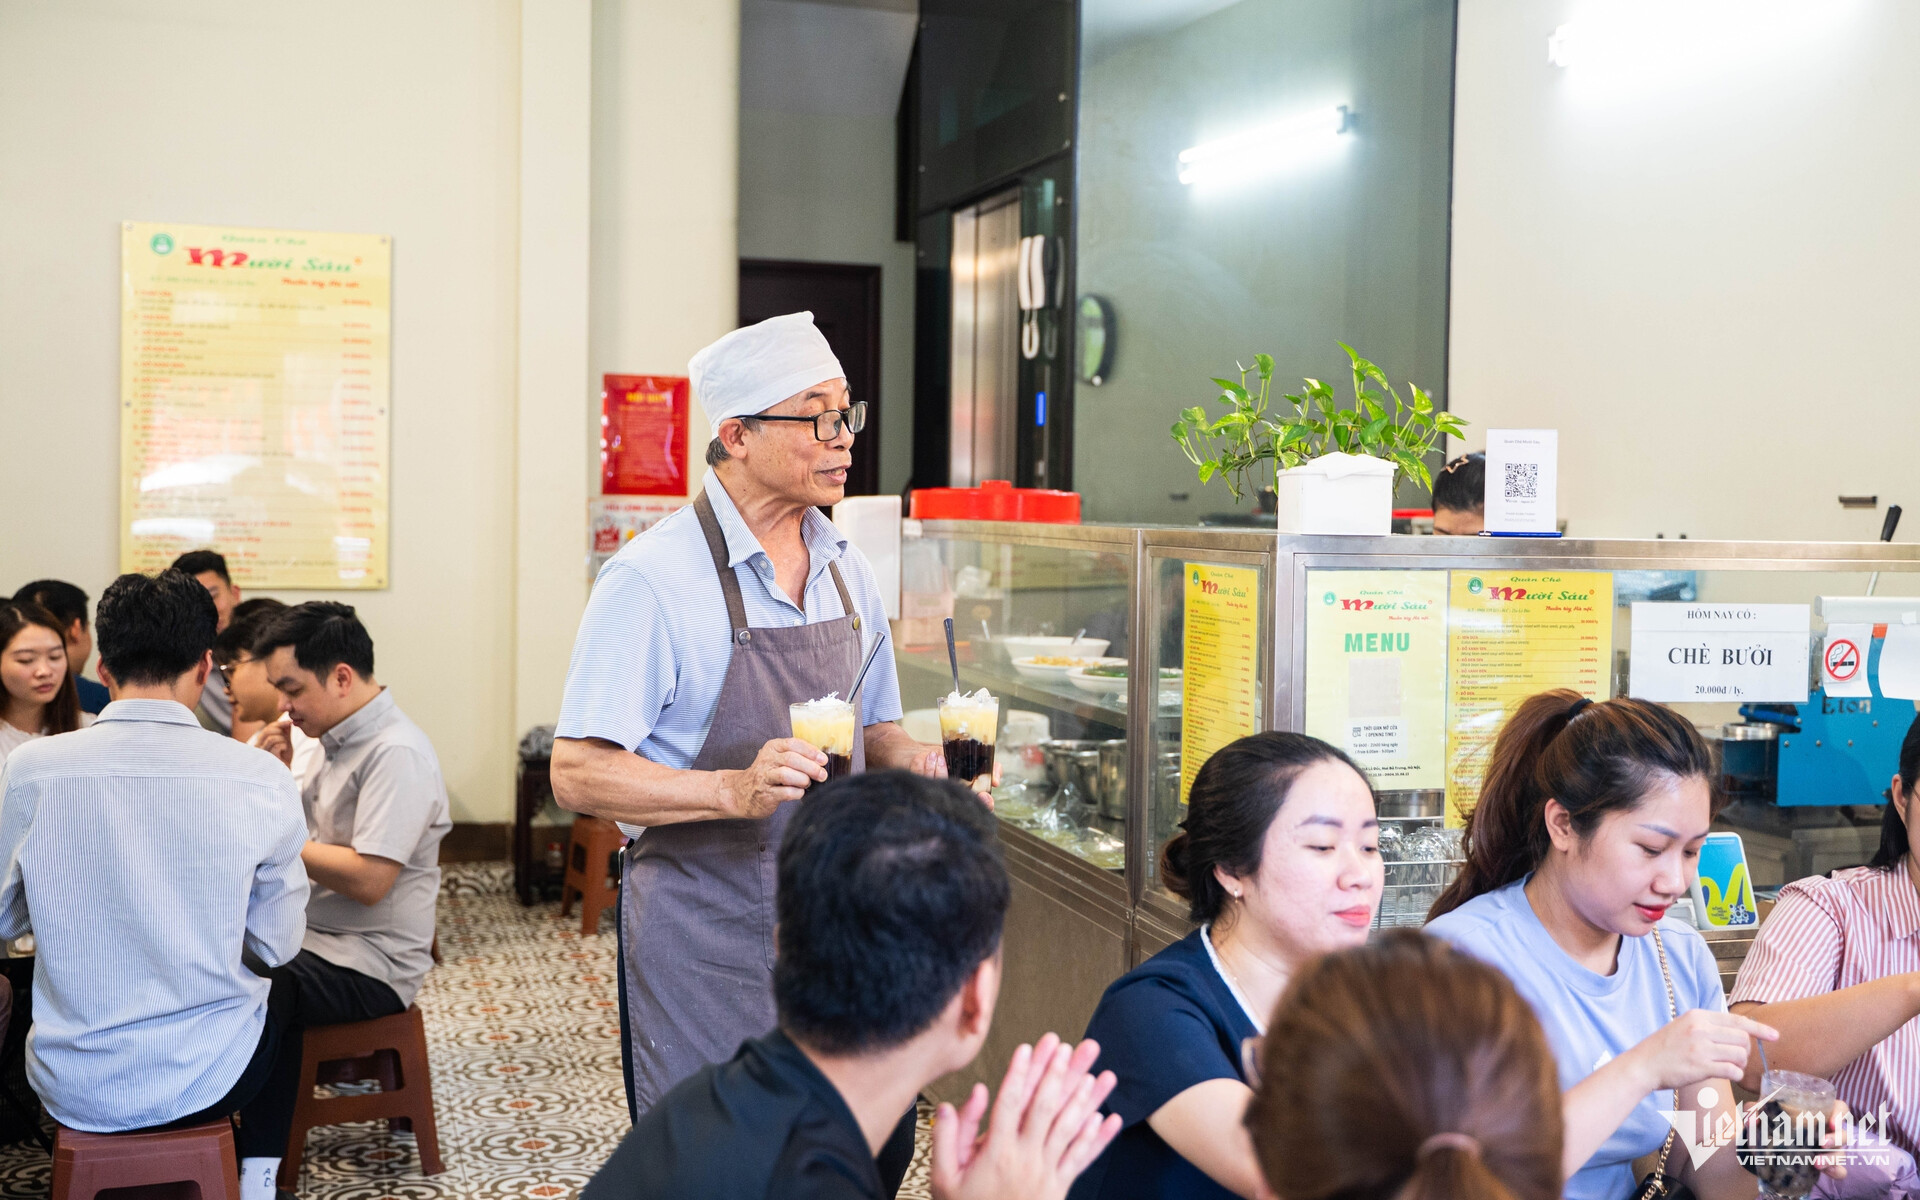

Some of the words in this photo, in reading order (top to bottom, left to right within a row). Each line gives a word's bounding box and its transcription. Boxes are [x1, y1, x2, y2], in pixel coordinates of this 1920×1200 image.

[1487, 586, 1553, 601] Mười
[1558, 590, 1588, 601] Sáu
[1401, 601, 1427, 610] Sáu
[1687, 609, 1711, 620] HÔM
[1713, 611, 1734, 620] NAY
[1736, 610, 1751, 620] CÓ
[1344, 632, 1410, 652] MENU
[1668, 643, 1711, 665] CHÈ
[1722, 644, 1773, 666] BƯỞI
